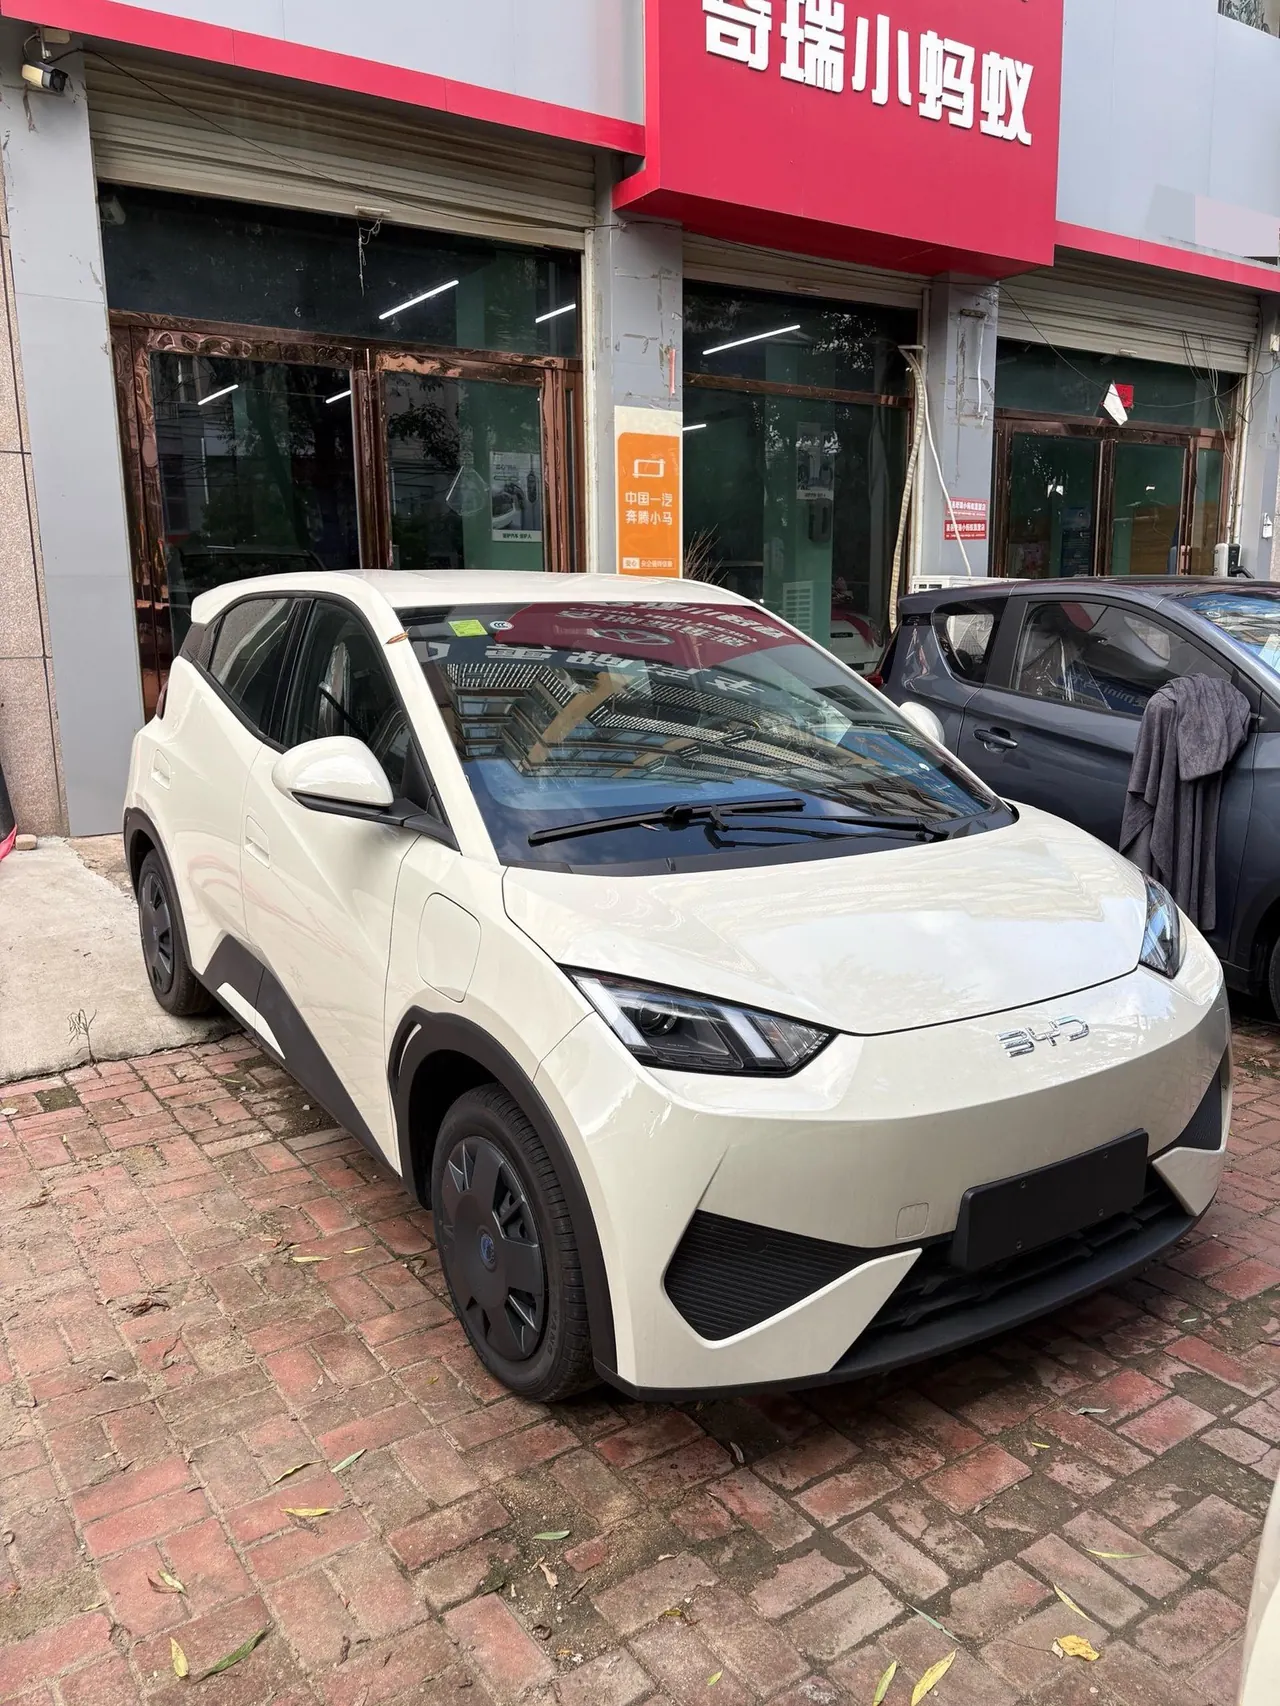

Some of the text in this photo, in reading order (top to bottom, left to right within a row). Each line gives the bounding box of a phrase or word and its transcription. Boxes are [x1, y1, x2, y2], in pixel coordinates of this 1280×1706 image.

[702, 0, 1034, 146] 奇瑞小蚂蚁
[625, 491, 673, 507] 中国一汽
[625, 509, 673, 526] 奔腾小马
[995, 1016, 1089, 1058] BYD
